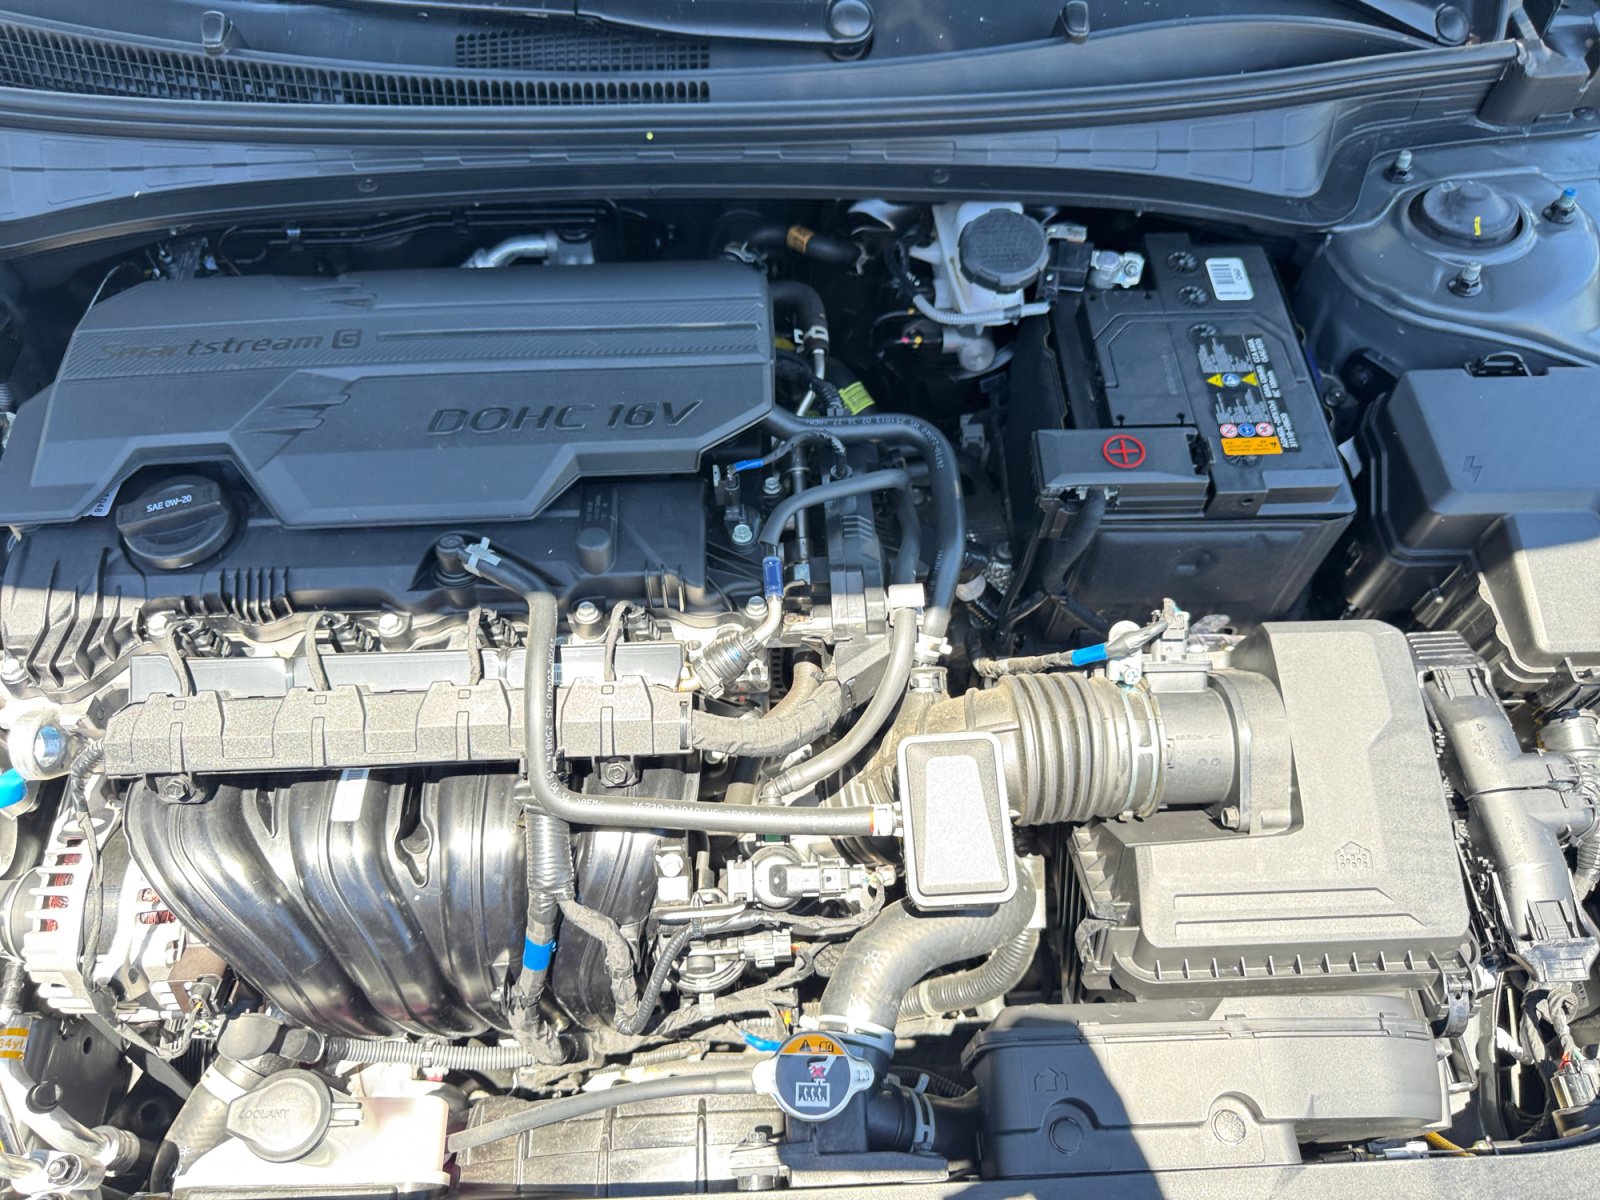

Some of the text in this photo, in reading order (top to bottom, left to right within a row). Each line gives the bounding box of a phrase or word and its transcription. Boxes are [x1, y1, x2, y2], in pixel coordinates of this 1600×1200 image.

[99, 334, 323, 360] Smartstream
[424, 398, 705, 436] DOHC 16V
[146, 493, 192, 513] SAE 0W-20
[545, 705, 553, 719] HS
[237, 1108, 291, 1120] COOLANT
